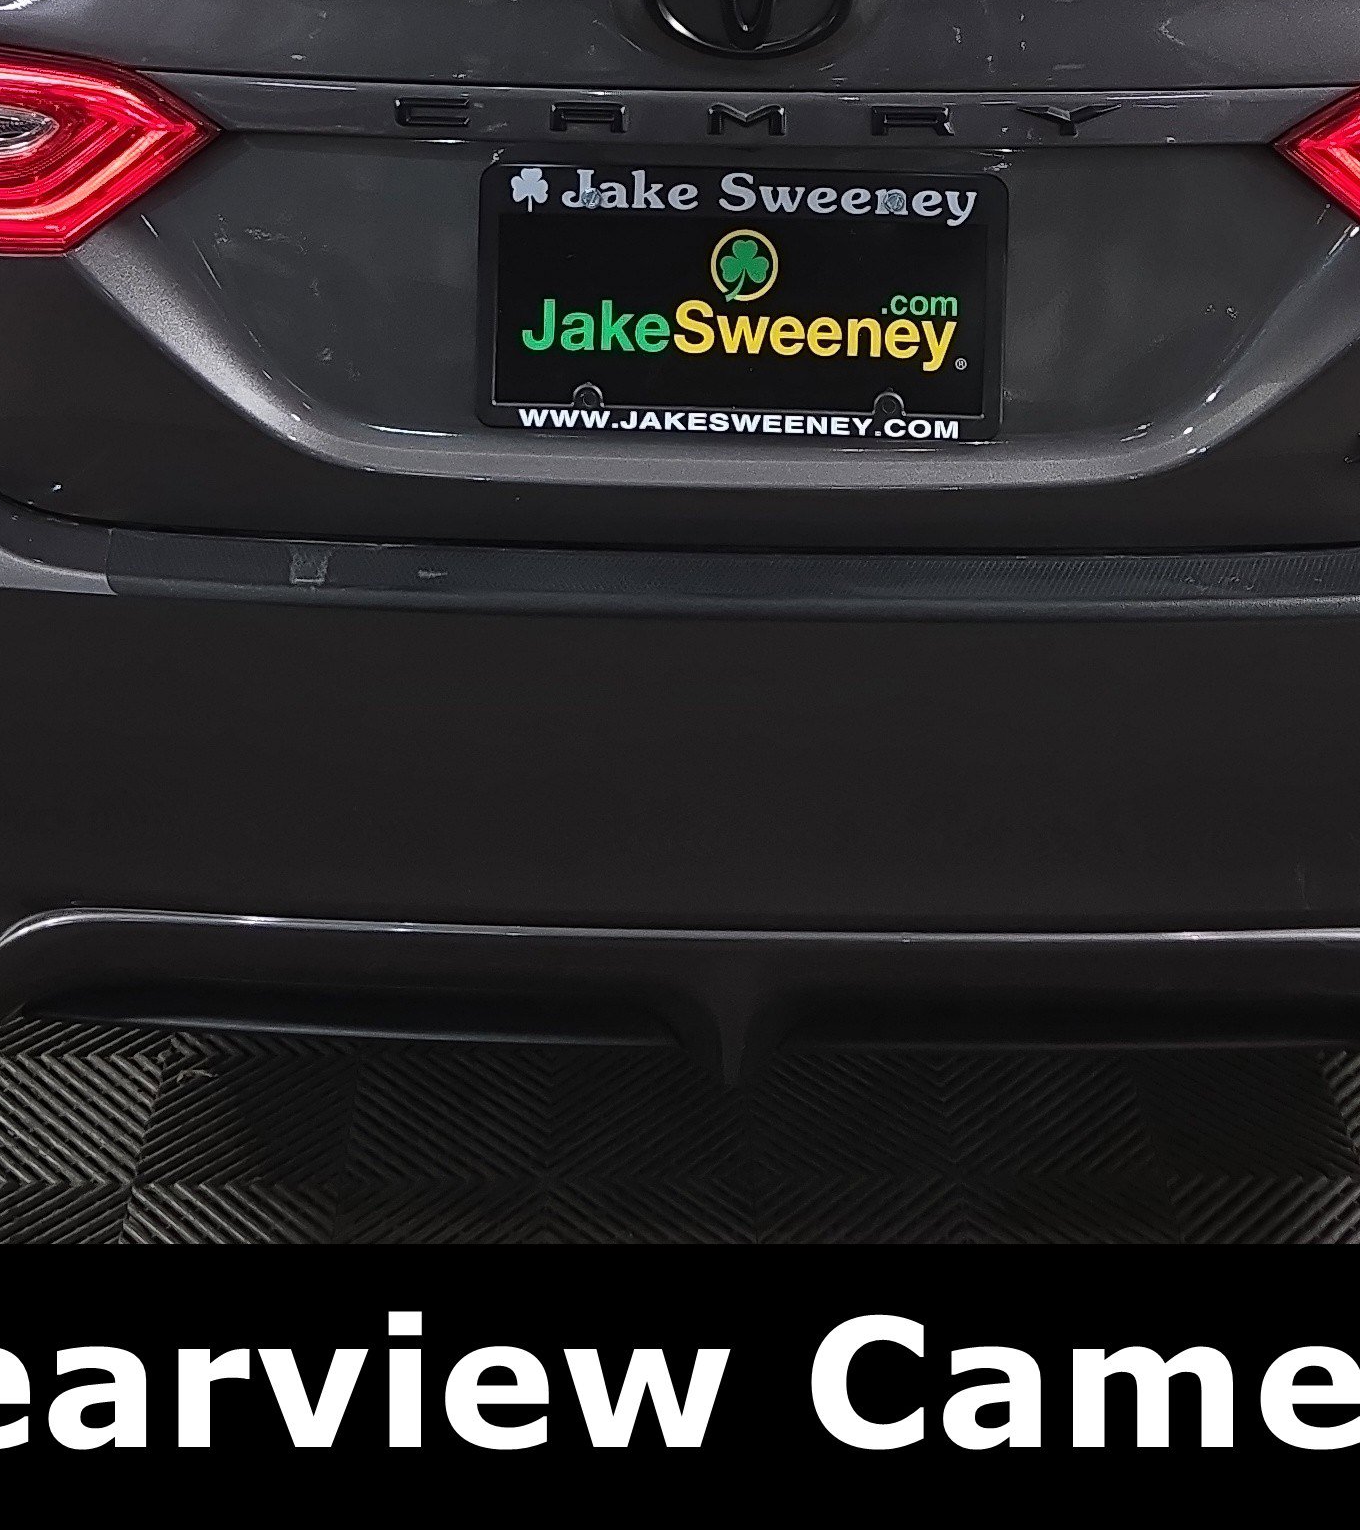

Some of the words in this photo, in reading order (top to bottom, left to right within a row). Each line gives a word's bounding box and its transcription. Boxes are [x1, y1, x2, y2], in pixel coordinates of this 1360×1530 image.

[393, 96, 1123, 138] CAMRY
[561, 169, 699, 211] Jake
[718, 172, 978, 227] Sweeney
[880, 294, 958, 317] .com
[518, 408, 960, 440] WWW.JAKESWEENEY.COM
